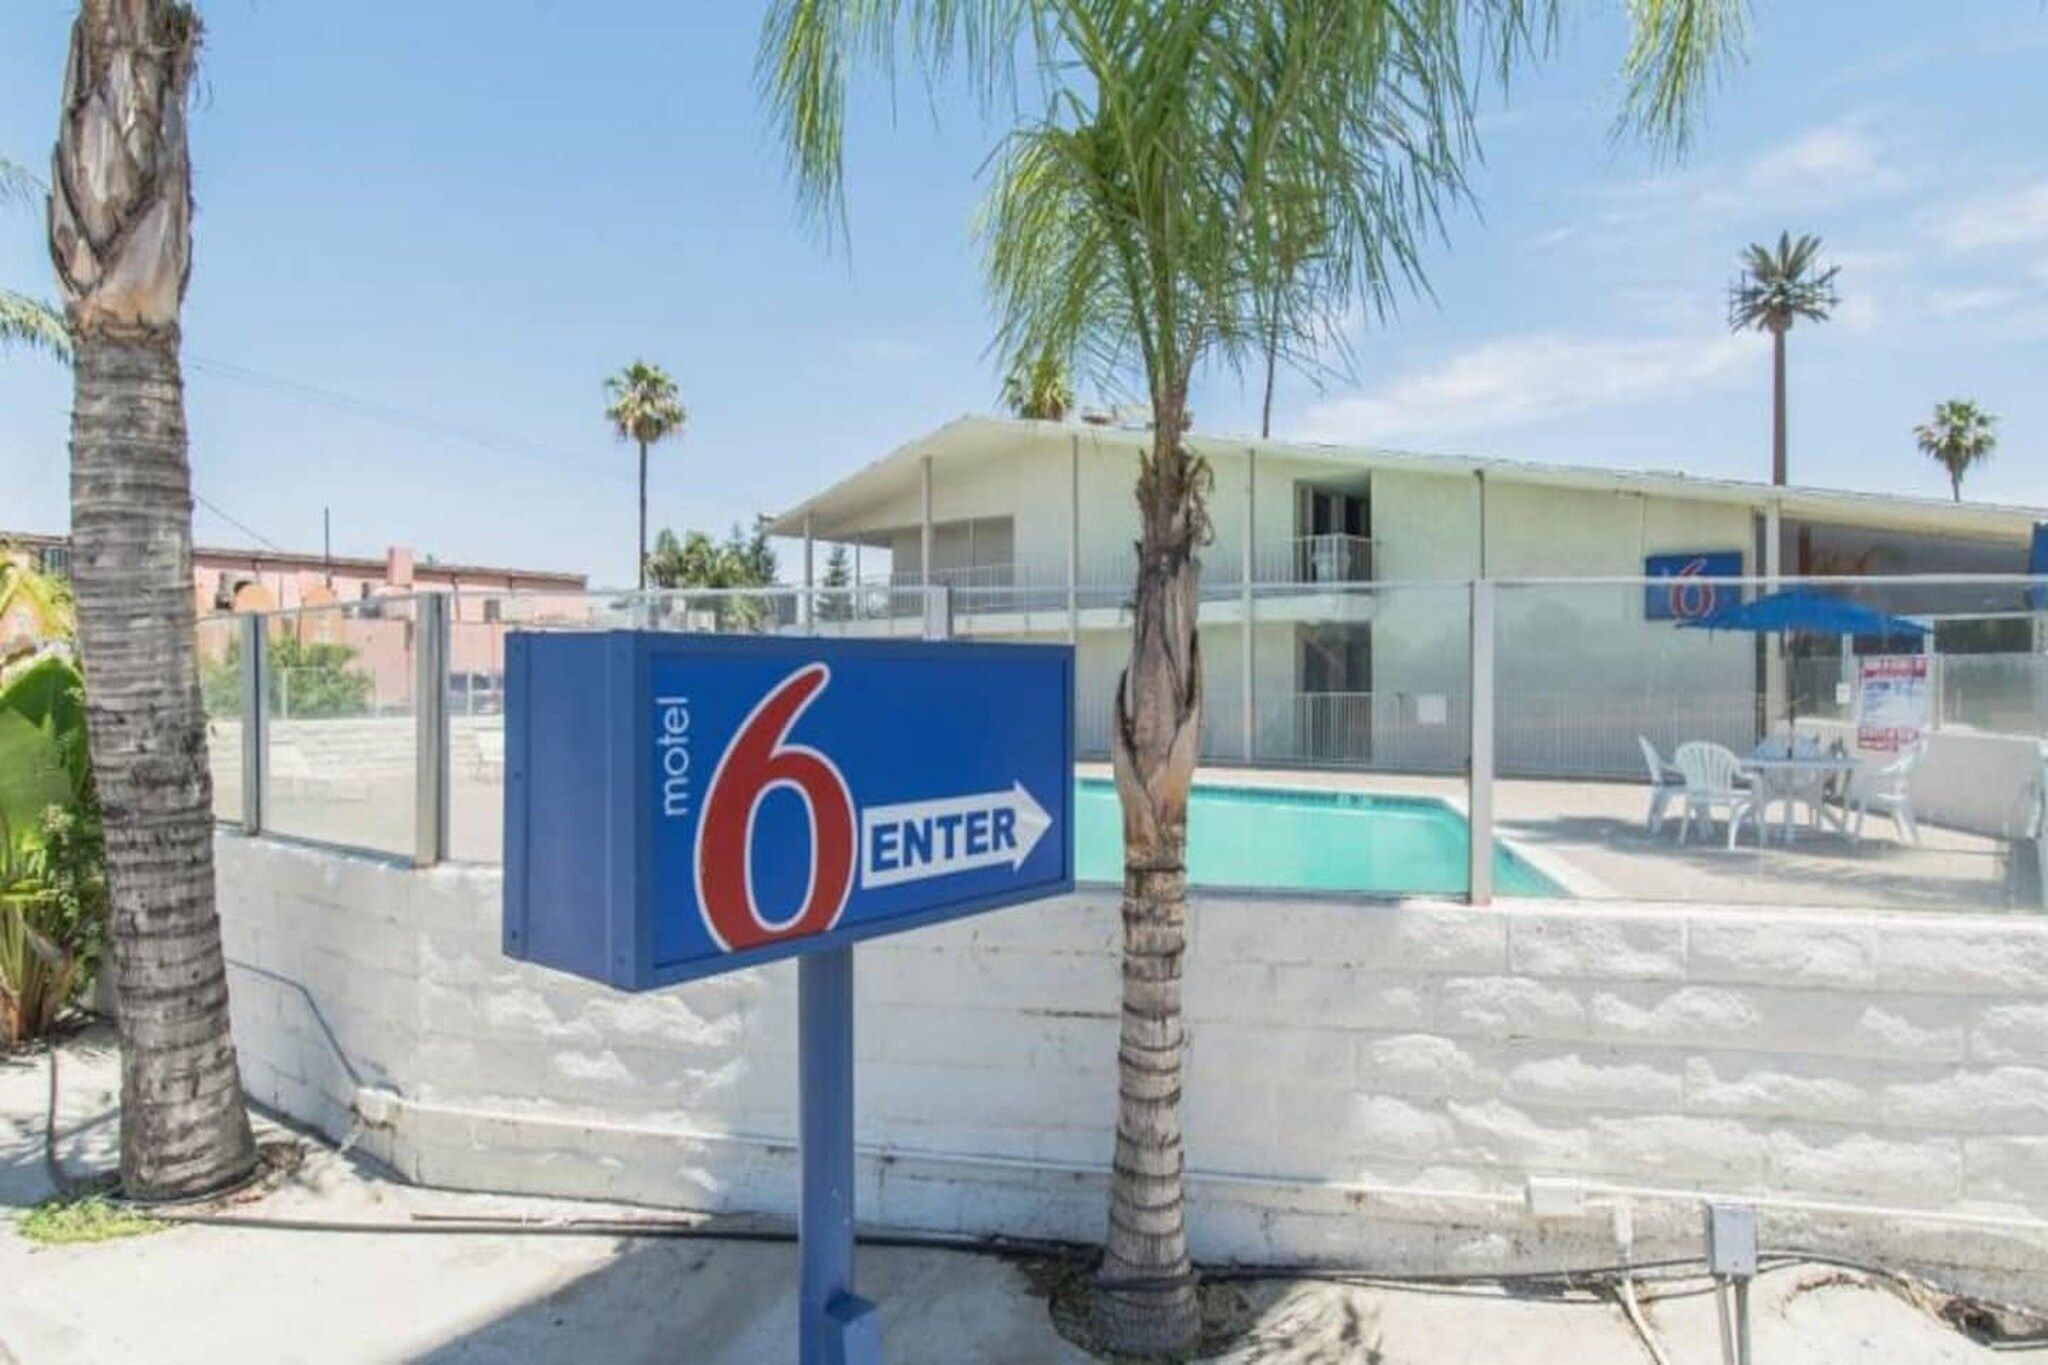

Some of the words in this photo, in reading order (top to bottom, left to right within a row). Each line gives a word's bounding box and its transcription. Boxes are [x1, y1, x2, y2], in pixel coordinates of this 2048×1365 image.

[1670, 558, 1715, 620] 6
[656, 697, 689, 815] motel
[693, 661, 858, 952] 6
[871, 807, 1018, 872] ENTER
